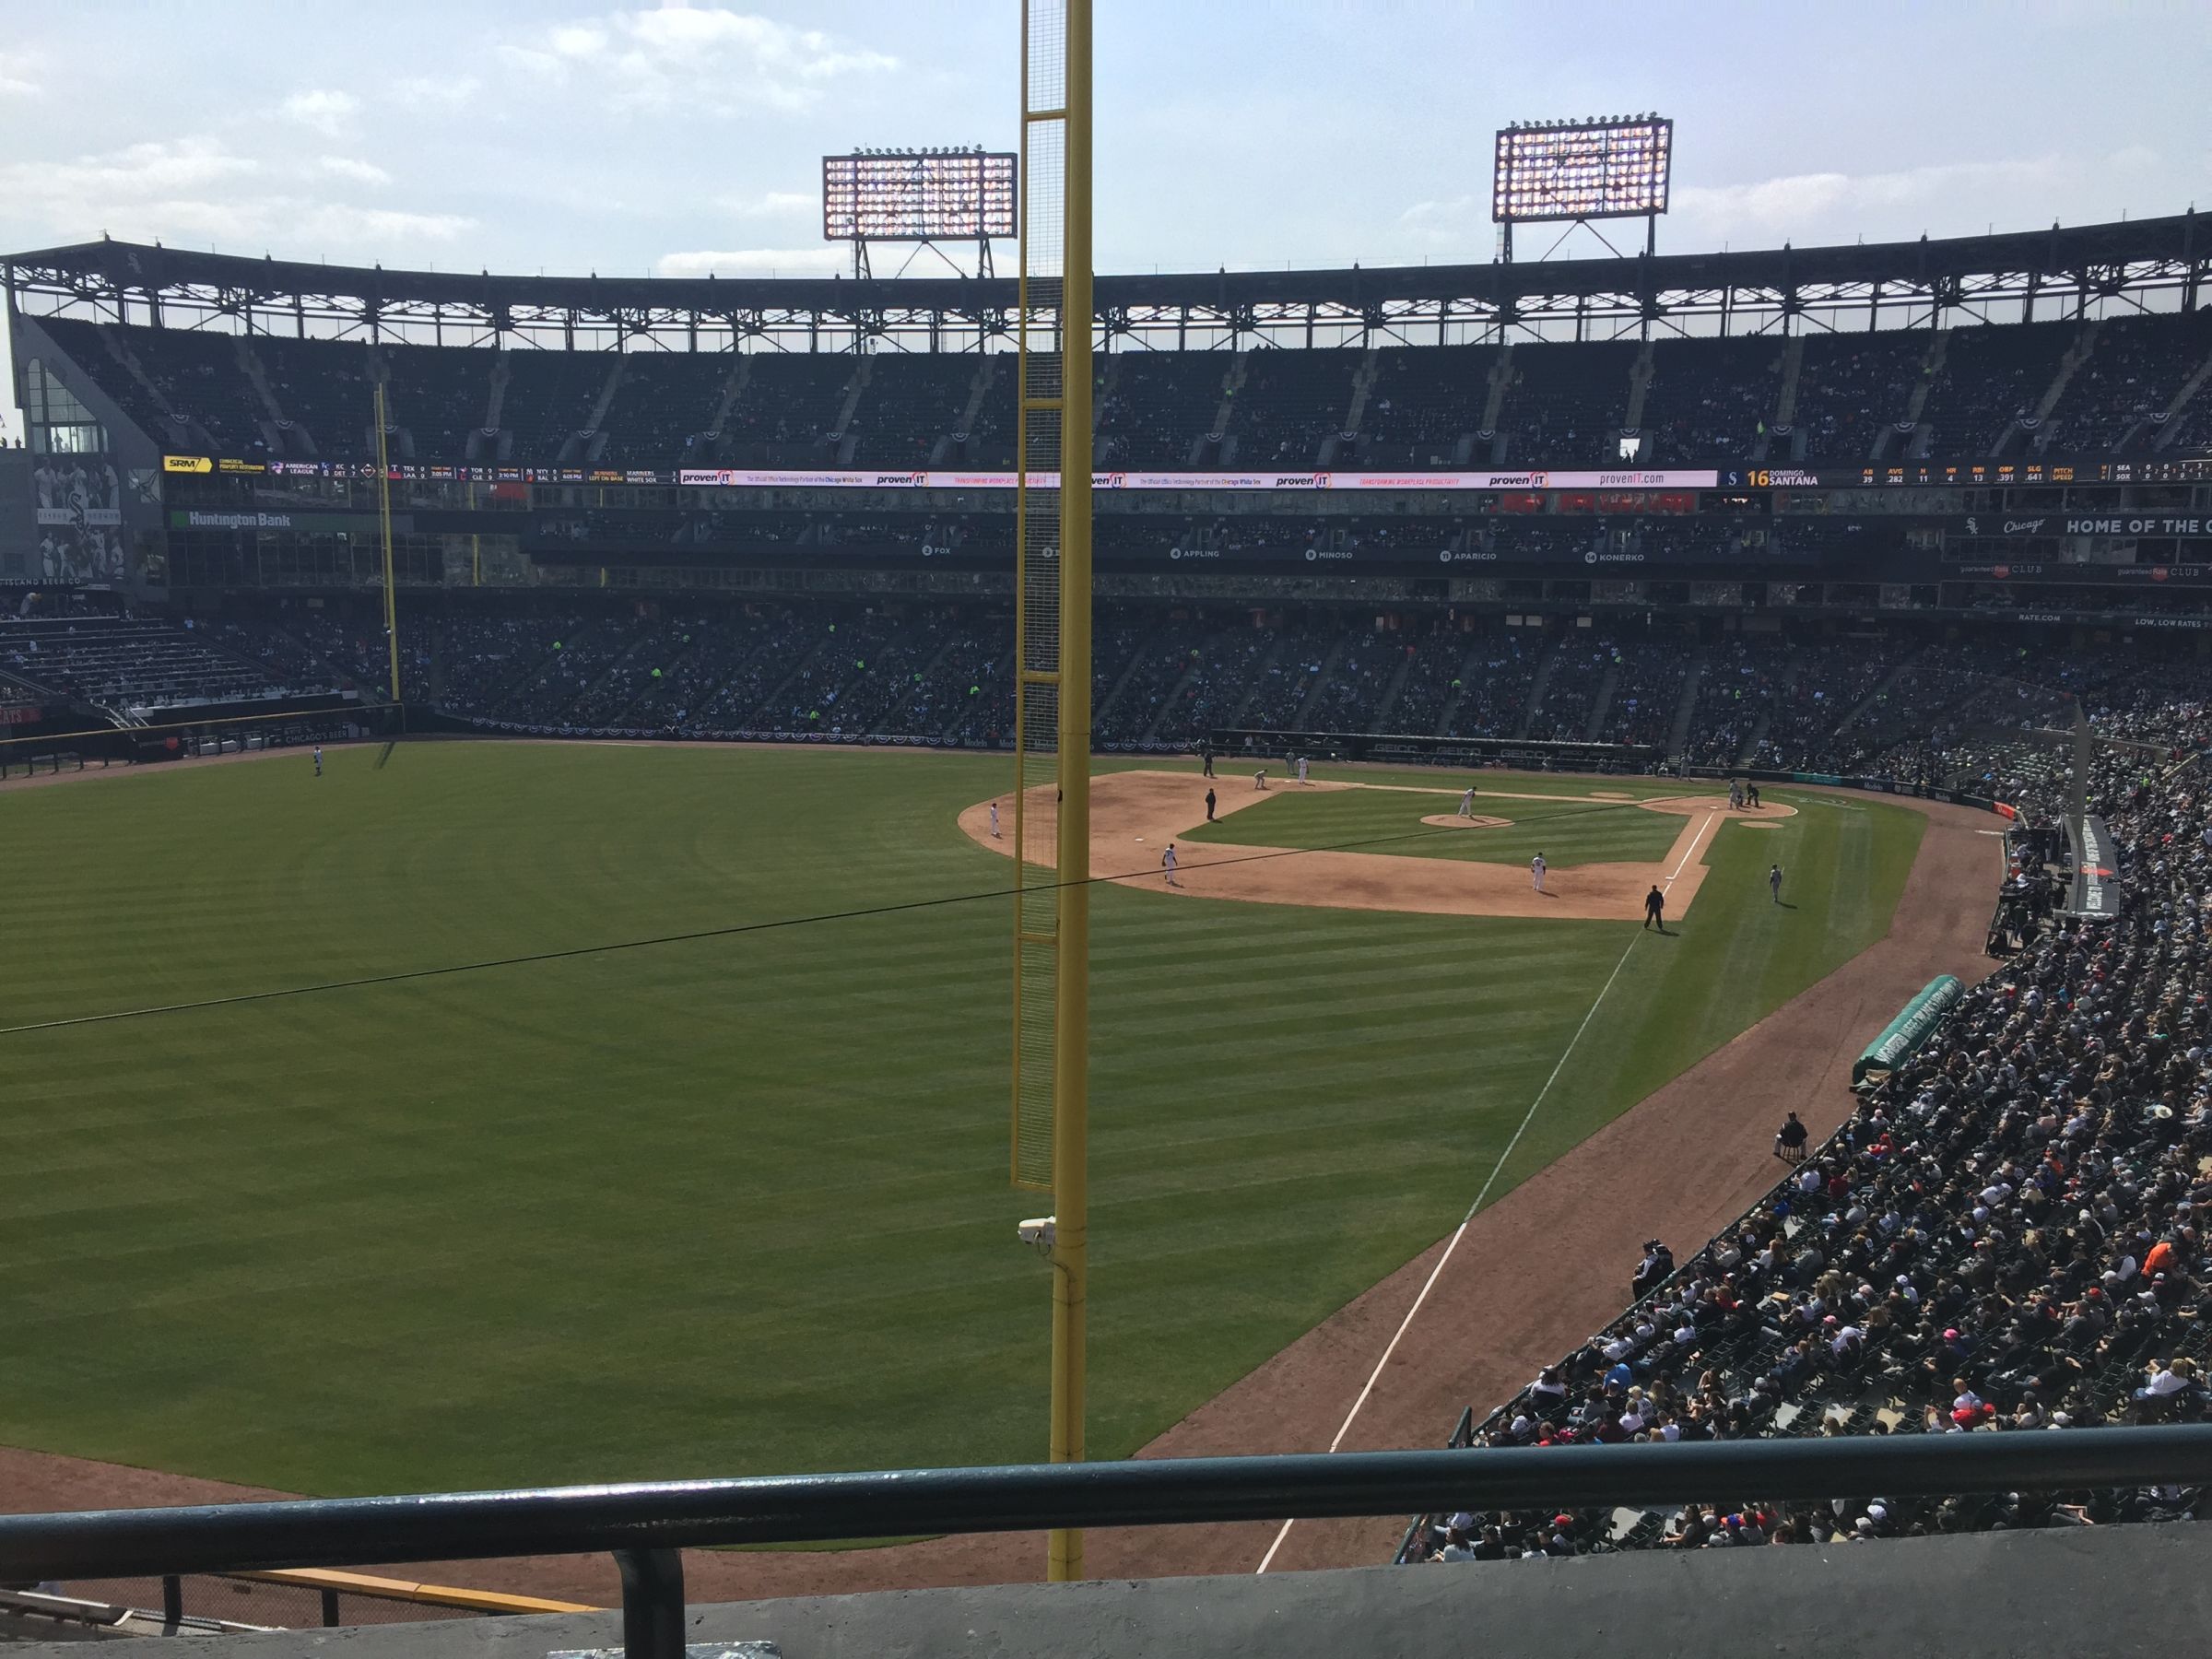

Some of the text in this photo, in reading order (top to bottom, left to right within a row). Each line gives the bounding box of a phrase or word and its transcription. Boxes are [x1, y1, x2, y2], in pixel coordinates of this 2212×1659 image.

[170, 459, 194, 468] SRM
[683, 475, 717, 483] proven
[877, 476, 912, 485] proven
[1276, 477, 1313, 487] proven
[1489, 476, 1544, 486] proven IT
[1600, 473, 1664, 486] provenIT.com
[1747, 470, 1769, 487] 16
[1769, 477, 1818, 486] SANTANA
[189, 512, 291, 530] Huntington Bank
[2004, 518, 2046, 534] Chicago
[2066, 519, 2122, 533] HOME
[2128, 519, 2156, 533] OF
[2162, 519, 2199, 533] THE
[1183, 549, 1219, 558] APPLING
[1319, 551, 1353, 559] MINOSO
[1453, 552, 1496, 560] APARICIO
[1599, 553, 1644, 561] KONERKO
[2011, 565, 2042, 573] CLUB
[2136, 618, 2157, 627] LOW,
[286, 729, 347, 744] CHICAGO'S BEER
[1374, 744, 1418, 752] GEICO
[1436, 747, 1481, 756] GEICO
[1500, 748, 1545, 759] GEICO
